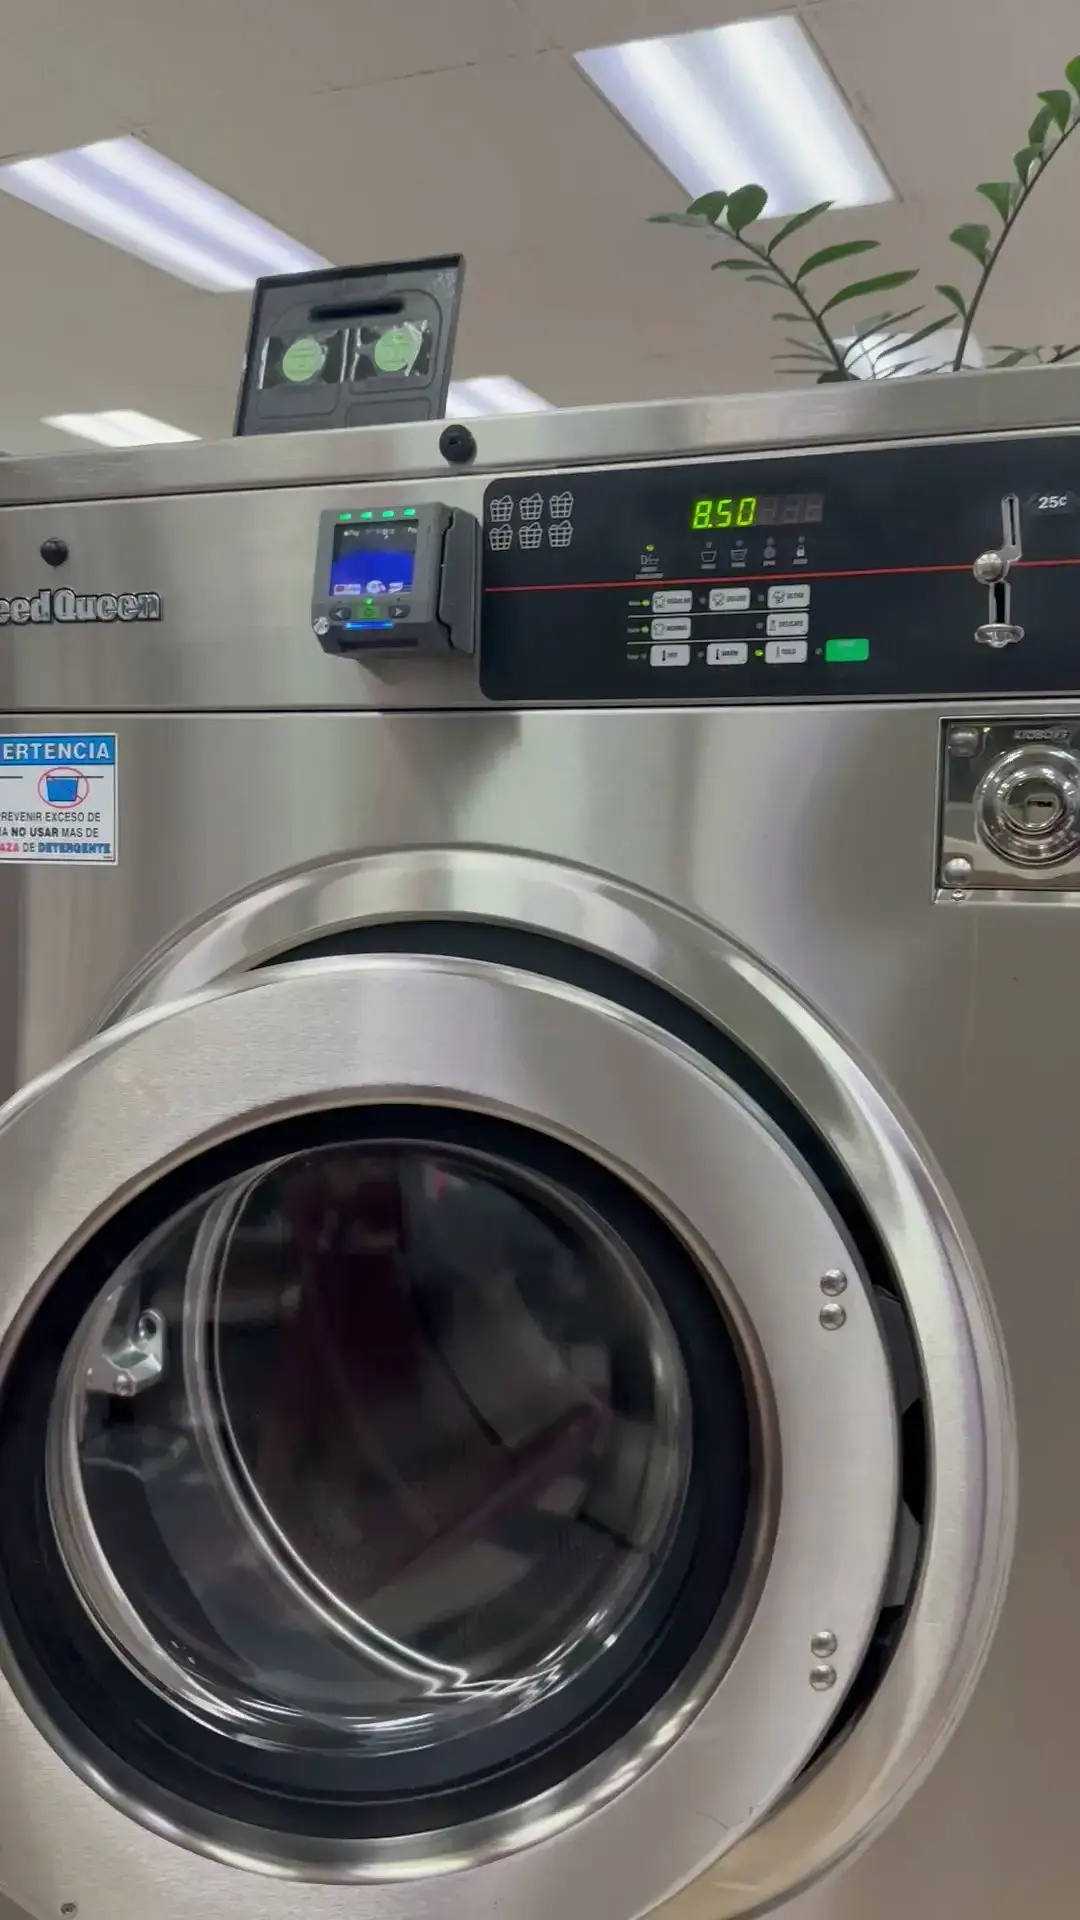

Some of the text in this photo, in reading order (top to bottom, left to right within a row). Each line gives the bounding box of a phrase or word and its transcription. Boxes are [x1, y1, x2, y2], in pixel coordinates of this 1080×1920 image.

[1038, 494, 1068, 509] 25¢
[692, 497, 757, 529] 8.50
[52, 587, 161, 622] Queen
[3, 742, 110, 760] ERTENCIA
[0, 812, 101, 822] REVENIR EXCESO DE
[0, 827, 99, 838] A NO USAR MAS DE
[22, 843, 36, 852] DE
[38, 843, 111, 854] DETERGENTE
